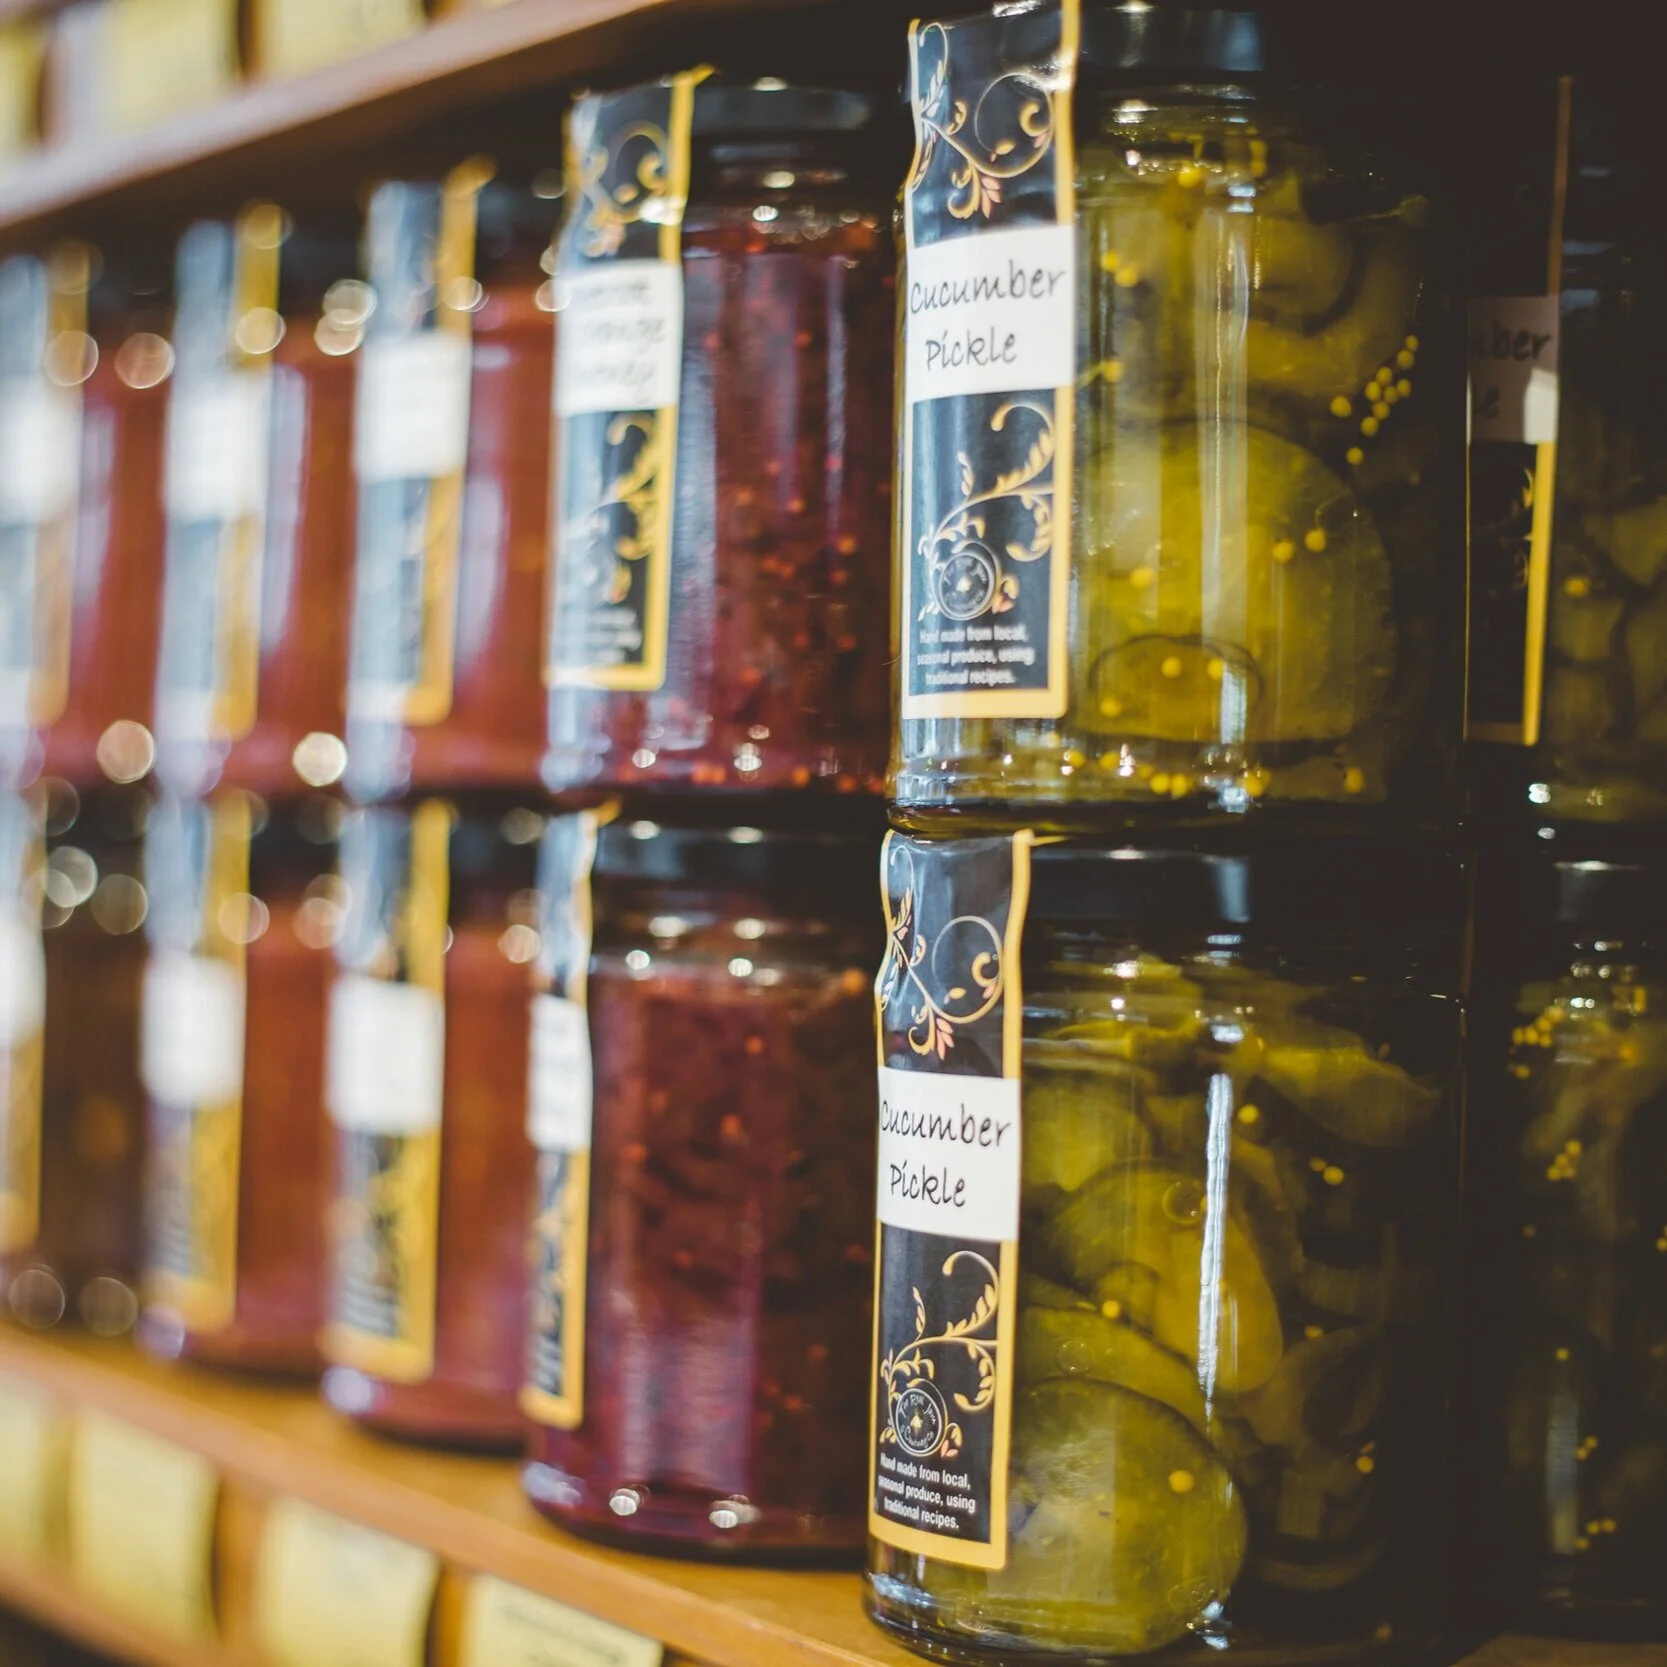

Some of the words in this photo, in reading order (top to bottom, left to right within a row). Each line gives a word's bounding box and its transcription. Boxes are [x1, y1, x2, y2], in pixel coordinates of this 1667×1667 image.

[910, 258, 1066, 315] Cucumber
[925, 326, 1018, 372] Pickle
[881, 1100, 1011, 1147] Cucumber
[890, 1159, 966, 1208] Pickle
[896, 1461, 918, 1477] made
[919, 1464, 940, 1483] from
[942, 1469, 971, 1491] local,
[905, 1485, 944, 1505] produce,
[946, 1494, 976, 1514] using
[920, 1510, 960, 1529] recipes.
